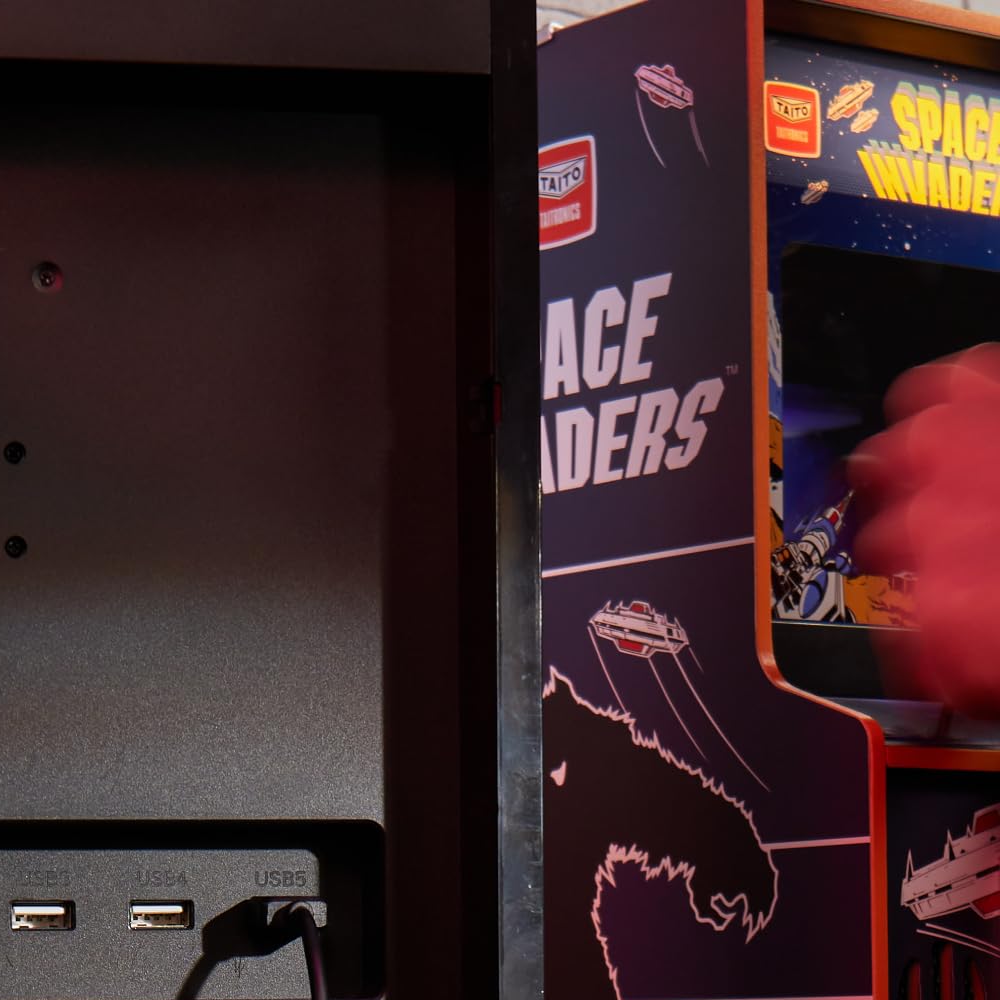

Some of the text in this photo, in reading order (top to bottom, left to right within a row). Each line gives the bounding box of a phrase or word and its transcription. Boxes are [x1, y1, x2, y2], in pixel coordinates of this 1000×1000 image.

[776, 102, 809, 119] TAITO
[539, 166, 582, 192] TAITO
[540, 272, 672, 400] ACE
[136, 870, 188, 888] USB4
[254, 870, 307, 888] USB5
